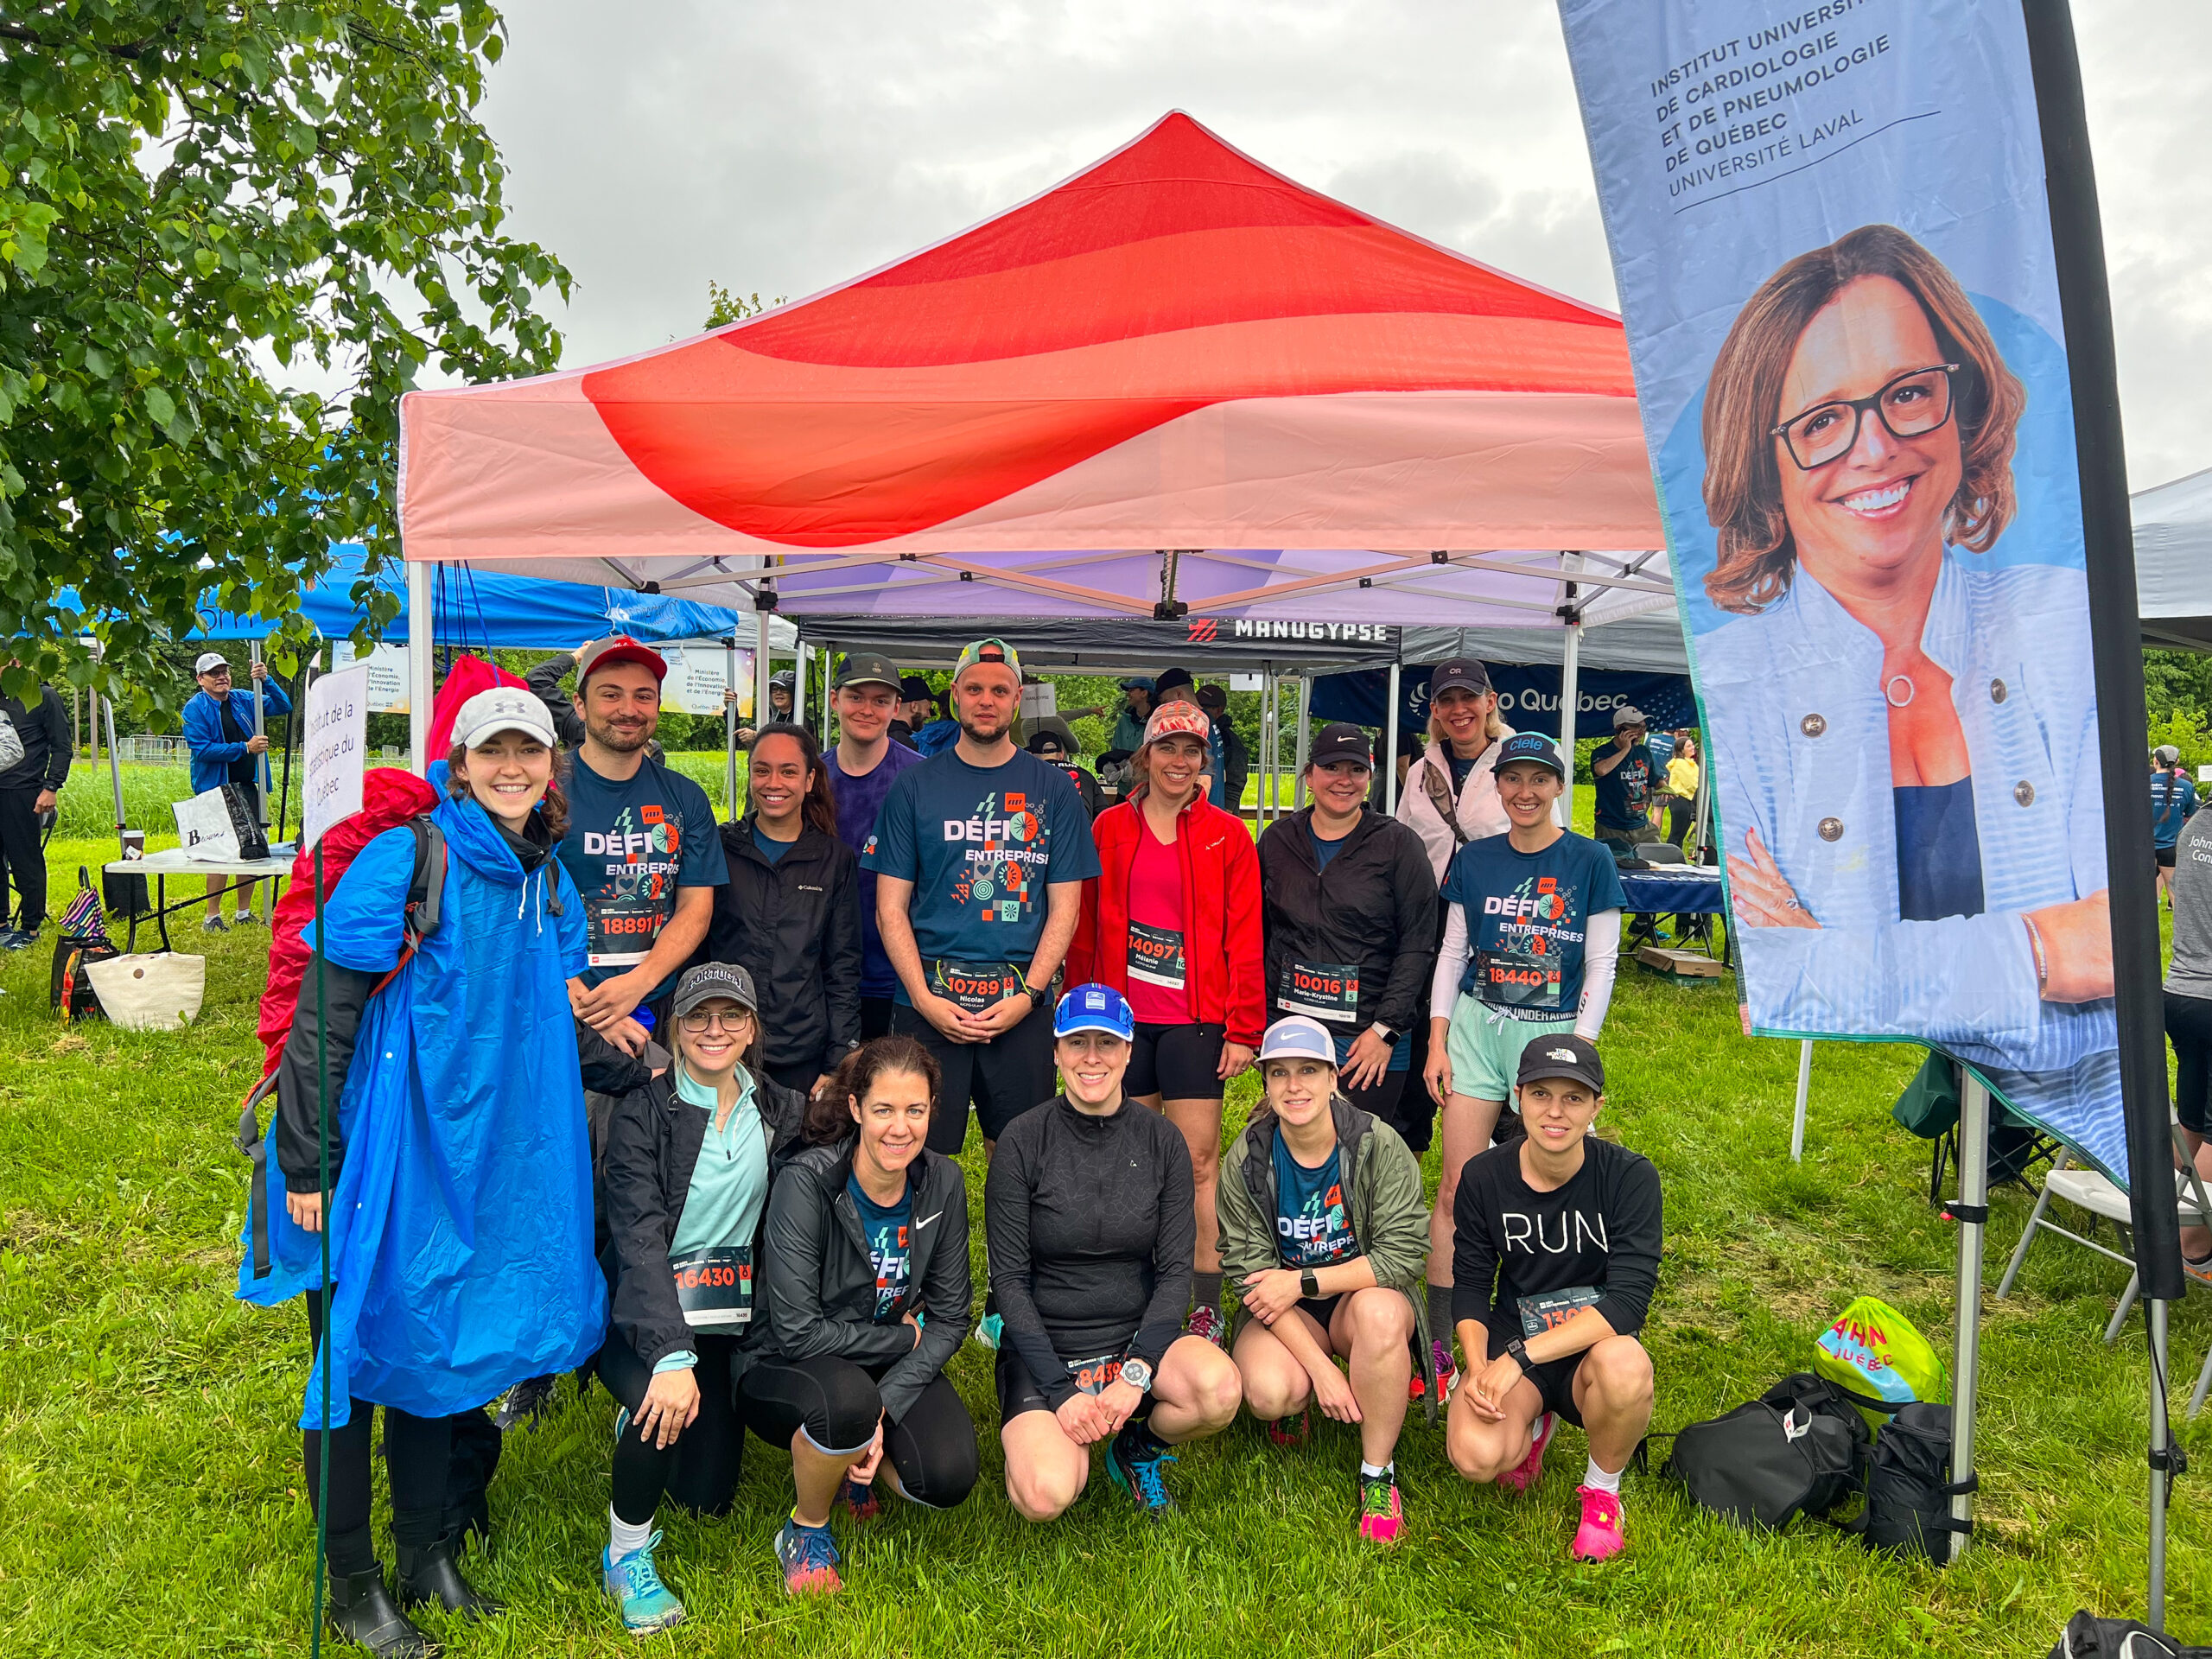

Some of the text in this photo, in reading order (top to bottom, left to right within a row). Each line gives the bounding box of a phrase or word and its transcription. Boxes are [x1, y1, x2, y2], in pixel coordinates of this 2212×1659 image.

[1651, 0, 1865, 97] INSTITUT UNIVERSI
[1656, 31, 1838, 123] DE CARDIOLOGIE
[1661, 34, 1890, 148] ET DE PNEUMOLOGIE
[1665, 113, 1787, 173] DE QUÉBEC
[1669, 109, 1863, 196] UNIVERSITÉ LAVAL
[1235, 620, 1387, 641] MANUGYPSE
[331, 703, 342, 723] de
[345, 699, 353, 719] la
[1521, 688, 1628, 712] Qubec
[341, 734, 354, 753] du
[1510, 737, 1543, 751] ciele
[944, 816, 1010, 842] DÉFI
[584, 830, 653, 855] DÉFI
[2189, 835, 2212, 849] John
[1484, 895, 1541, 918] DÉFI
[601, 917, 652, 934] 18891
[1499, 922, 1584, 943] ENTREPRISES
[1128, 935, 1175, 959] 14097
[947, 977, 1000, 995] 10789
[1294, 973, 1341, 994] 10016
[1490, 968, 1542, 987] 18440
[1294, 988, 1338, 1001] Marie-Krystine
[1277, 1214, 1332, 1239] DÉFI
[1503, 1210, 1608, 1254] RUN
[673, 1267, 734, 1289] 16430
